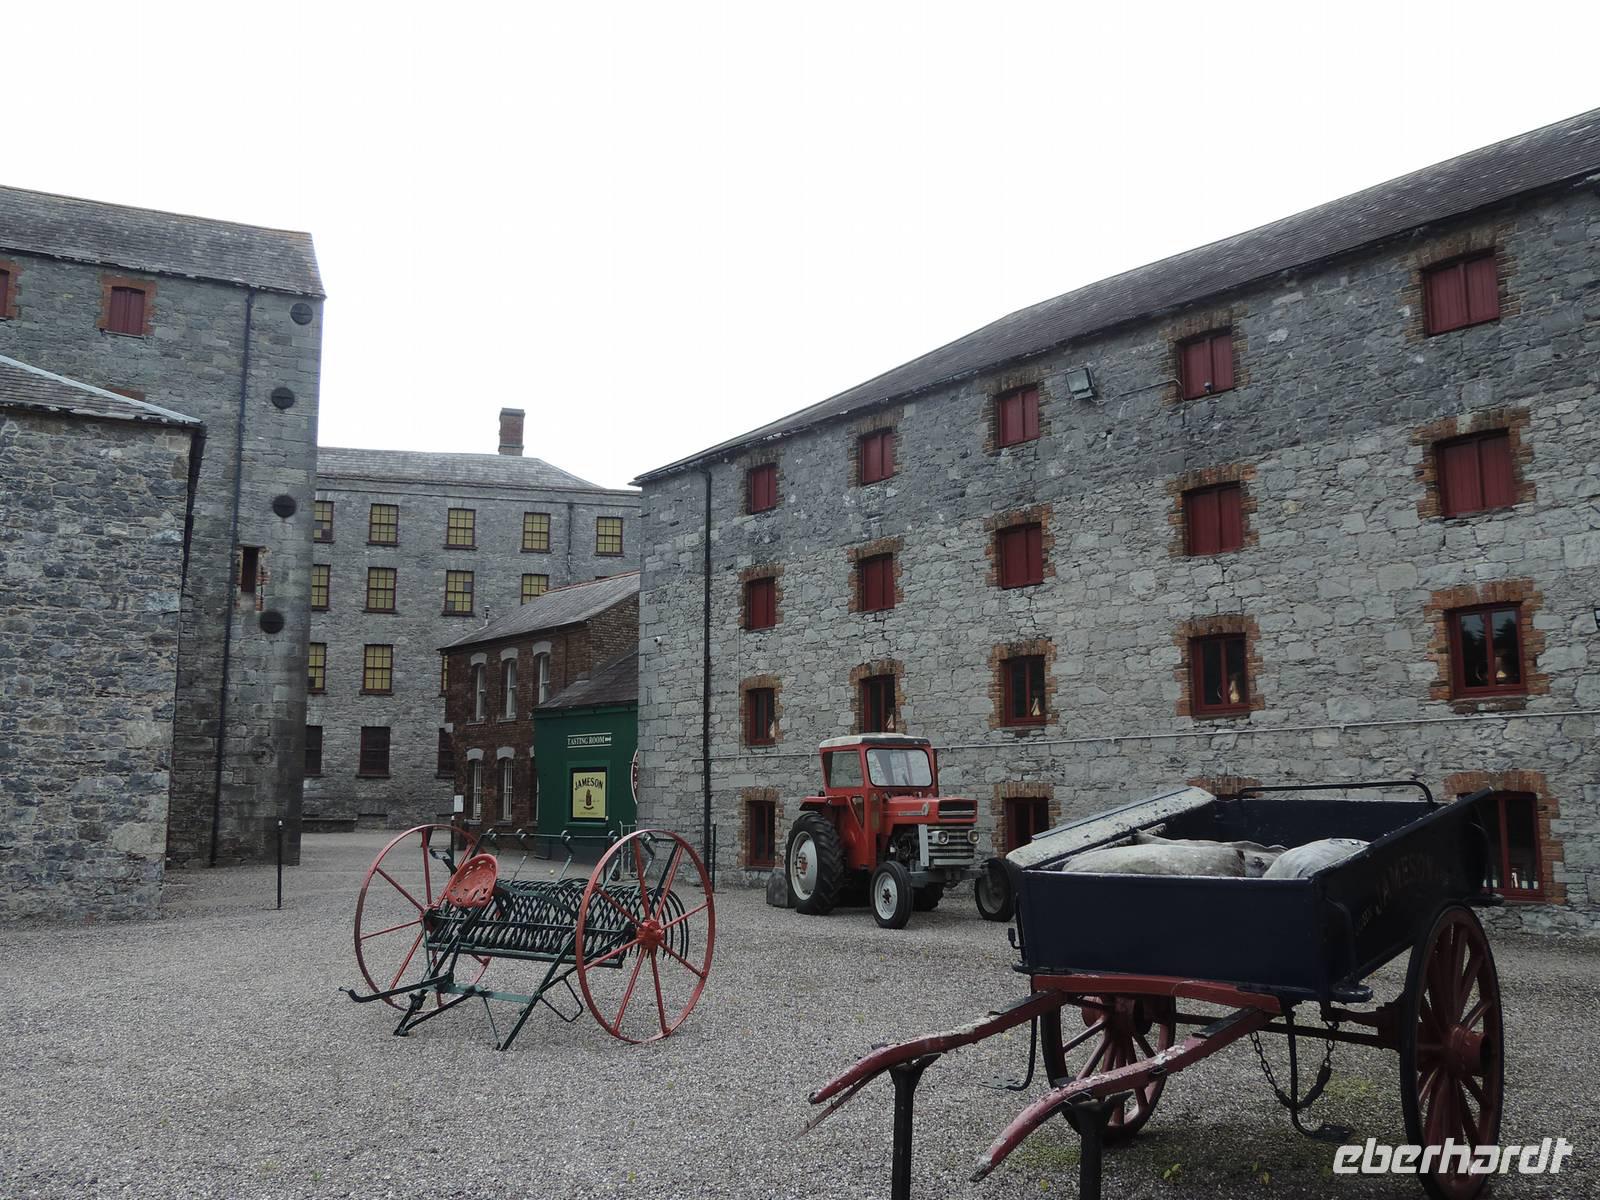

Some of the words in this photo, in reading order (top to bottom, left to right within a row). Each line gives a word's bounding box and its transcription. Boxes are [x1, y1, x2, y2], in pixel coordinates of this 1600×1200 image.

[568, 737, 588, 746] TASTING
[589, 735, 605, 744] ROOM
[575, 777, 603, 790] JAMESON
